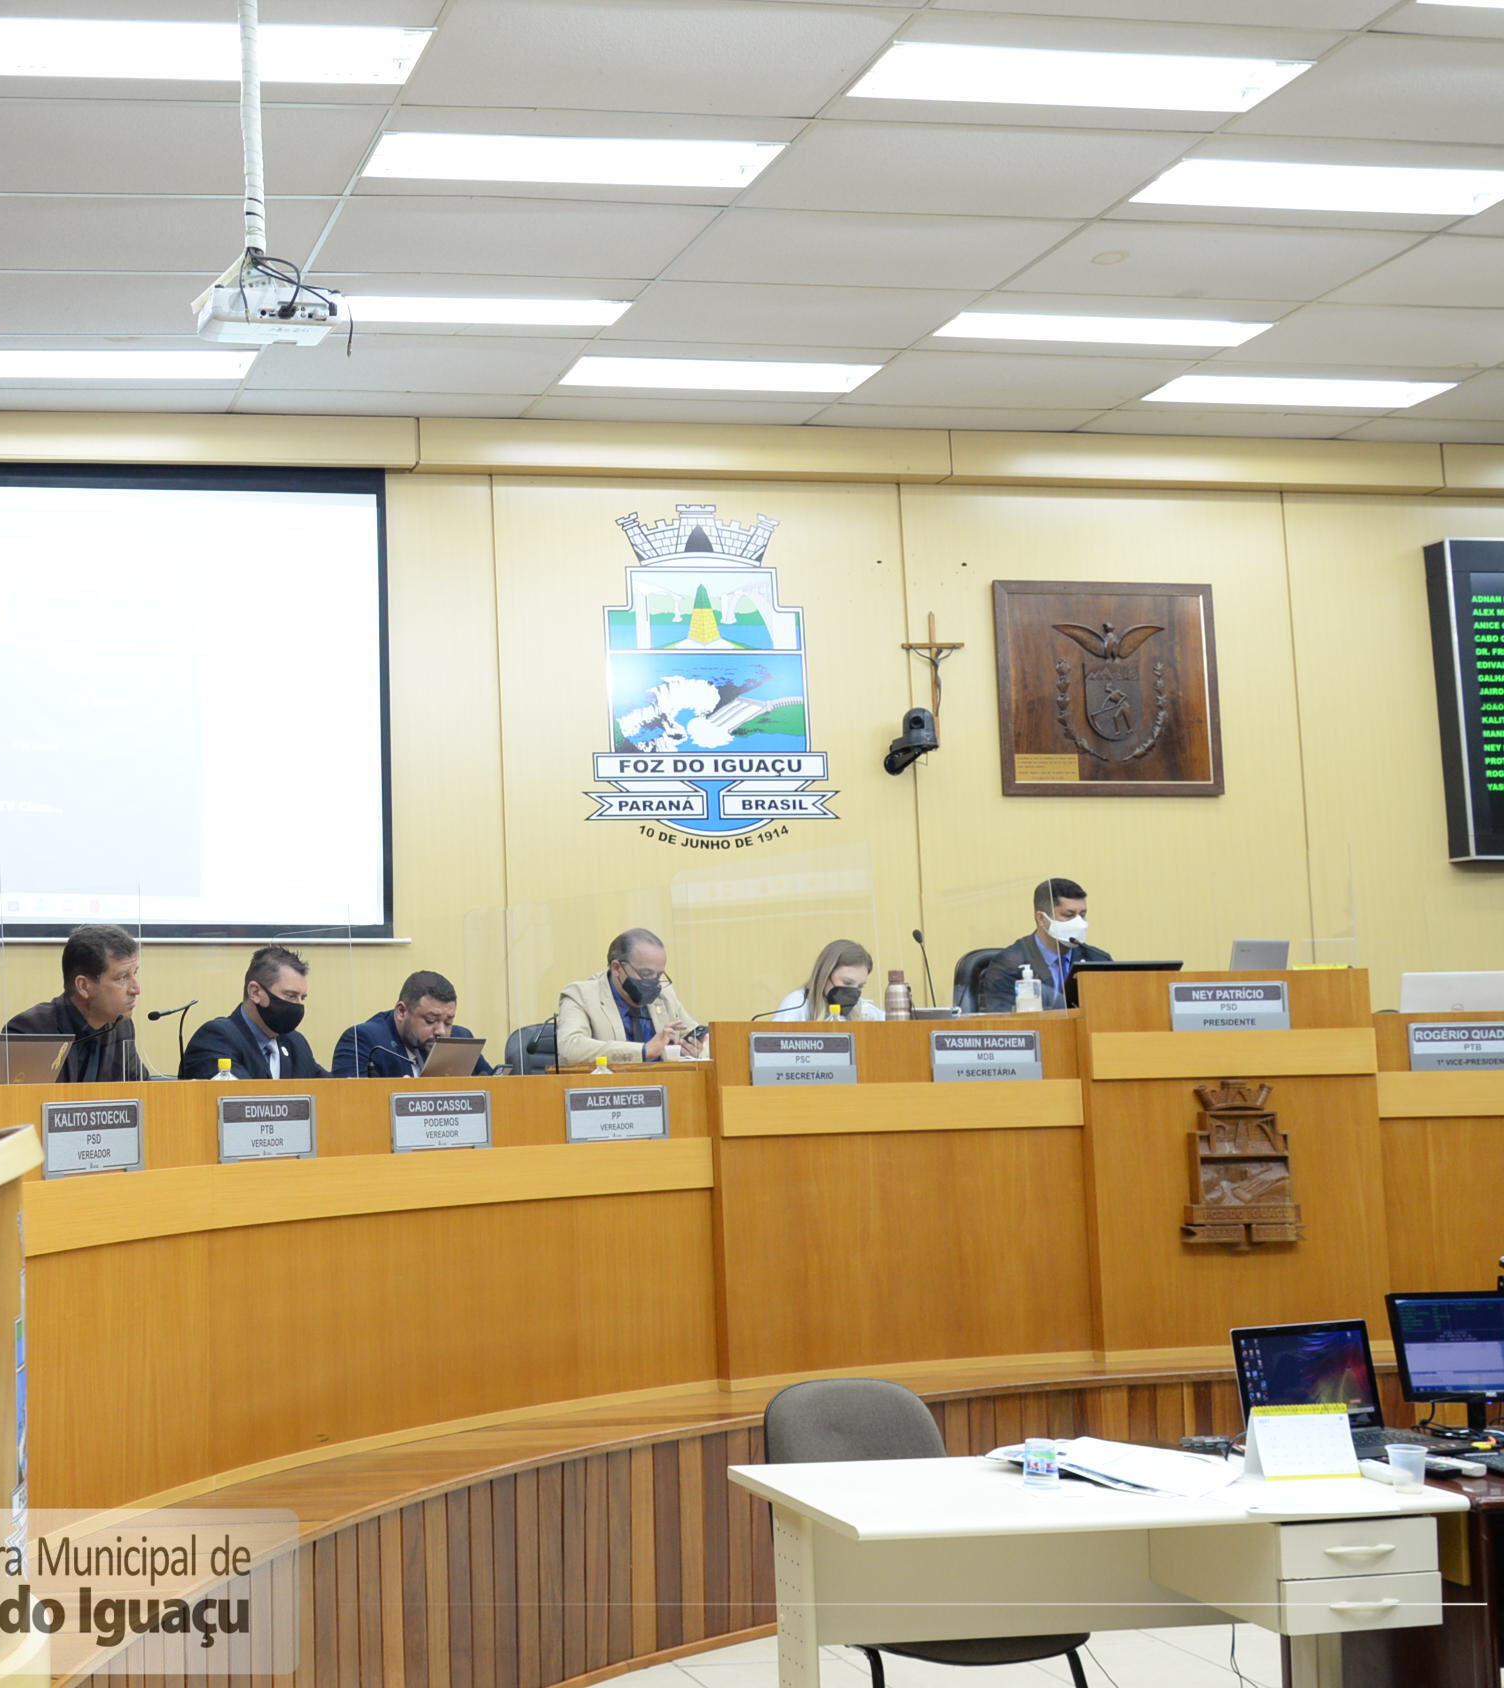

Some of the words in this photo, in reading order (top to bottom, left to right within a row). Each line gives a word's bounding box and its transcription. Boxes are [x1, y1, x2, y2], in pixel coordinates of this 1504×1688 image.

[1473, 608, 1495, 616] ALEX
[1474, 635, 1499, 643] CABO
[619, 759, 665, 774] FOZ
[673, 759, 704, 773] DO
[713, 759, 803, 778] IGUAÇU
[617, 797, 694, 812] PARANÁ
[742, 798, 809, 811] BRASIL
[638, 825, 655, 838] 10
[658, 832, 677, 845] DE
[681, 837, 731, 850] JUNHO
[735, 836, 754, 849] DE
[757, 824, 790, 843] 1914
[1192, 990, 1213, 1000] NEY
[1215, 987, 1264, 1000] PATRÍCIO
[1220, 1003, 1238, 1011] PSD
[1203, 1018, 1256, 1026] PRESIDENTE
[1415, 1028, 1469, 1041] ROGÉRIO
[780, 1039, 824, 1050] MANINHO
[944, 1037, 982, 1048] YASMIN
[984, 1037, 1025, 1048] HACHEM
[1463, 1043, 1482, 1051] PTB
[795, 1055, 811, 1064] PSC
[977, 1052, 995, 1061] MDB
[786, 1070, 834, 1080] SECRETÁRIO
[966, 1067, 1017, 1077] SECRETÁRIA
[408, 1100, 435, 1112] CABO
[436, 1099, 472, 1111] CASSOL
[586, 1095, 611, 1107] ALEX
[613, 1094, 645, 1106] MEYER
[245, 1105, 288, 1118] EDIVALDO
[611, 1111, 621, 1120] PP
[54, 1111, 88, 1127] KALITO
[89, 1109, 131, 1125] STOECKL
[424, 1117, 459, 1127] PODEMOS
[260, 1124, 274, 1134] PTB
[600, 1122, 634, 1131] VEREADOR
[86, 1133, 102, 1145] PSD
[426, 1130, 459, 1139] VEREADOR
[251, 1138, 284, 1148] VEREADOR
[77, 1148, 111, 1160] VEREADOR
